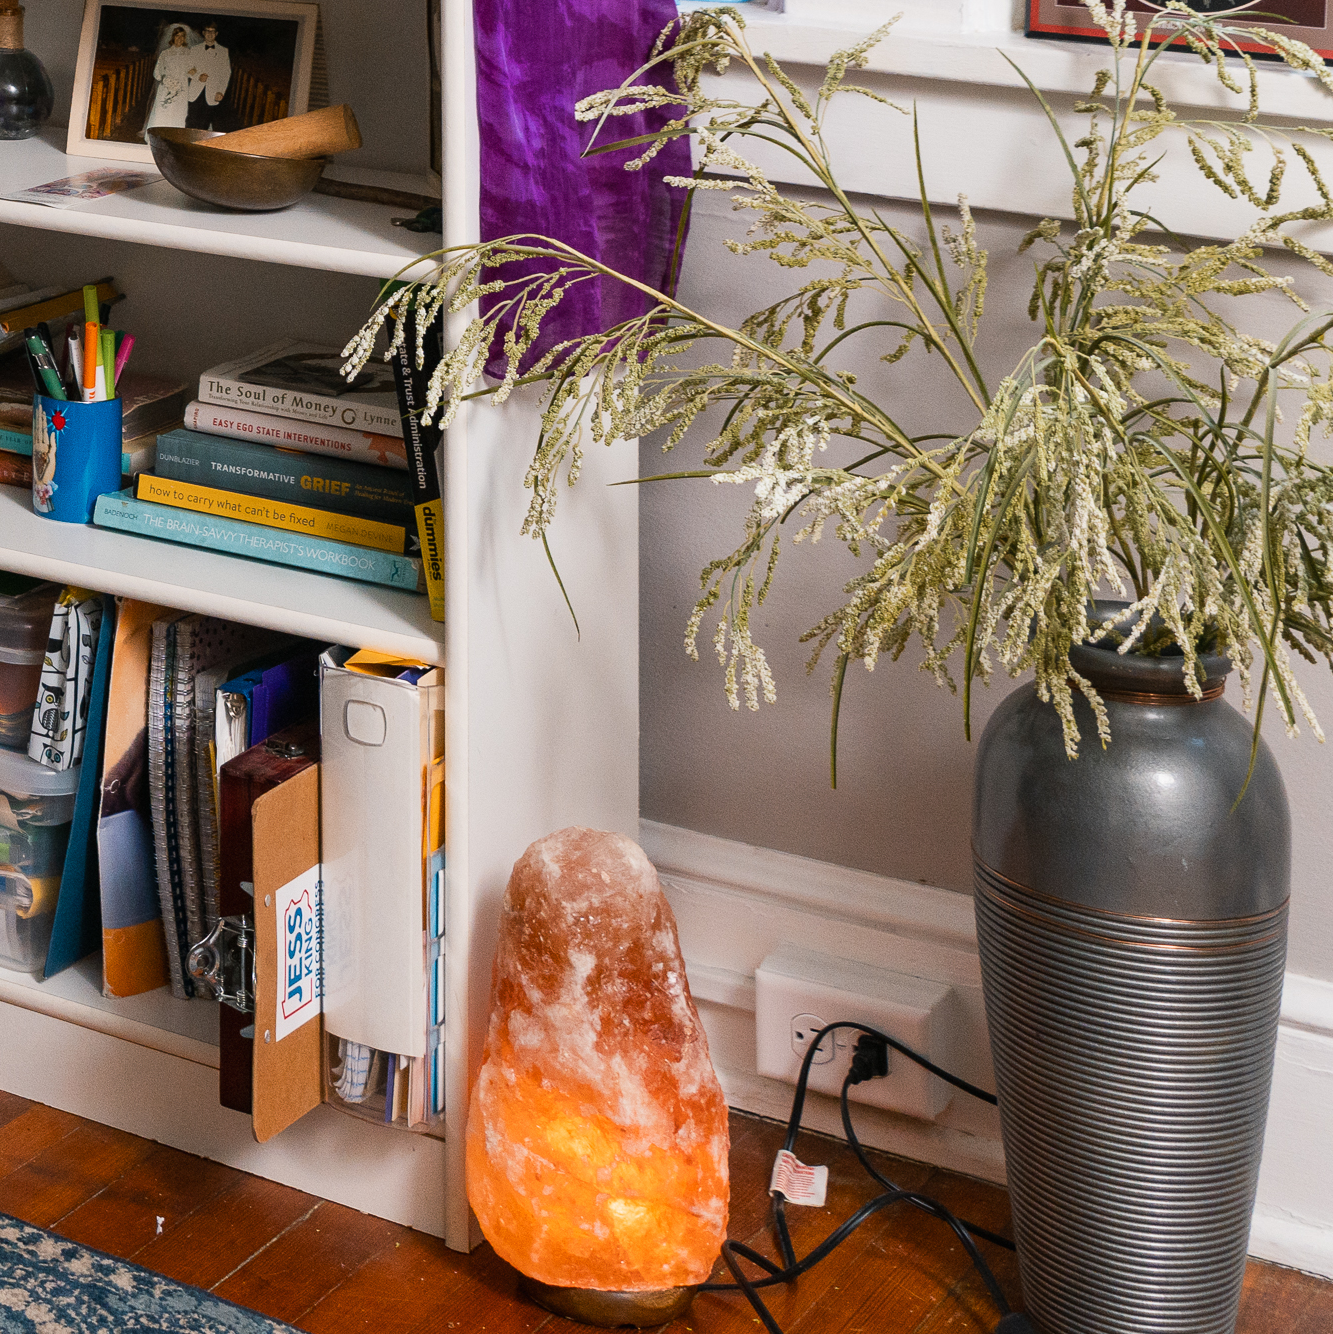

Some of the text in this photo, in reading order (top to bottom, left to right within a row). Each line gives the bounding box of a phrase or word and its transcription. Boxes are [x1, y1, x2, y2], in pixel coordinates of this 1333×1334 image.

[207, 380, 397, 427] The Soul of Money Lynne
[403, 377, 427, 489] Trust Administration
[212, 417, 352, 452] EASY EGO STATE INTERVENTIONS
[159, 452, 351, 497] DUNBLAZIER TRANSFORMATIVE GRIEF
[104, 508, 376, 571] BADENOCH THE BRAIN-SAVVY THERAPIST'S WORKBOOK
[149, 484, 394, 543] how to carry what can't be fixed MEGAN DEVINE
[422, 506, 442, 582] dummies
[288, 907, 303, 1003] JESS
[304, 917, 313, 978] KING
